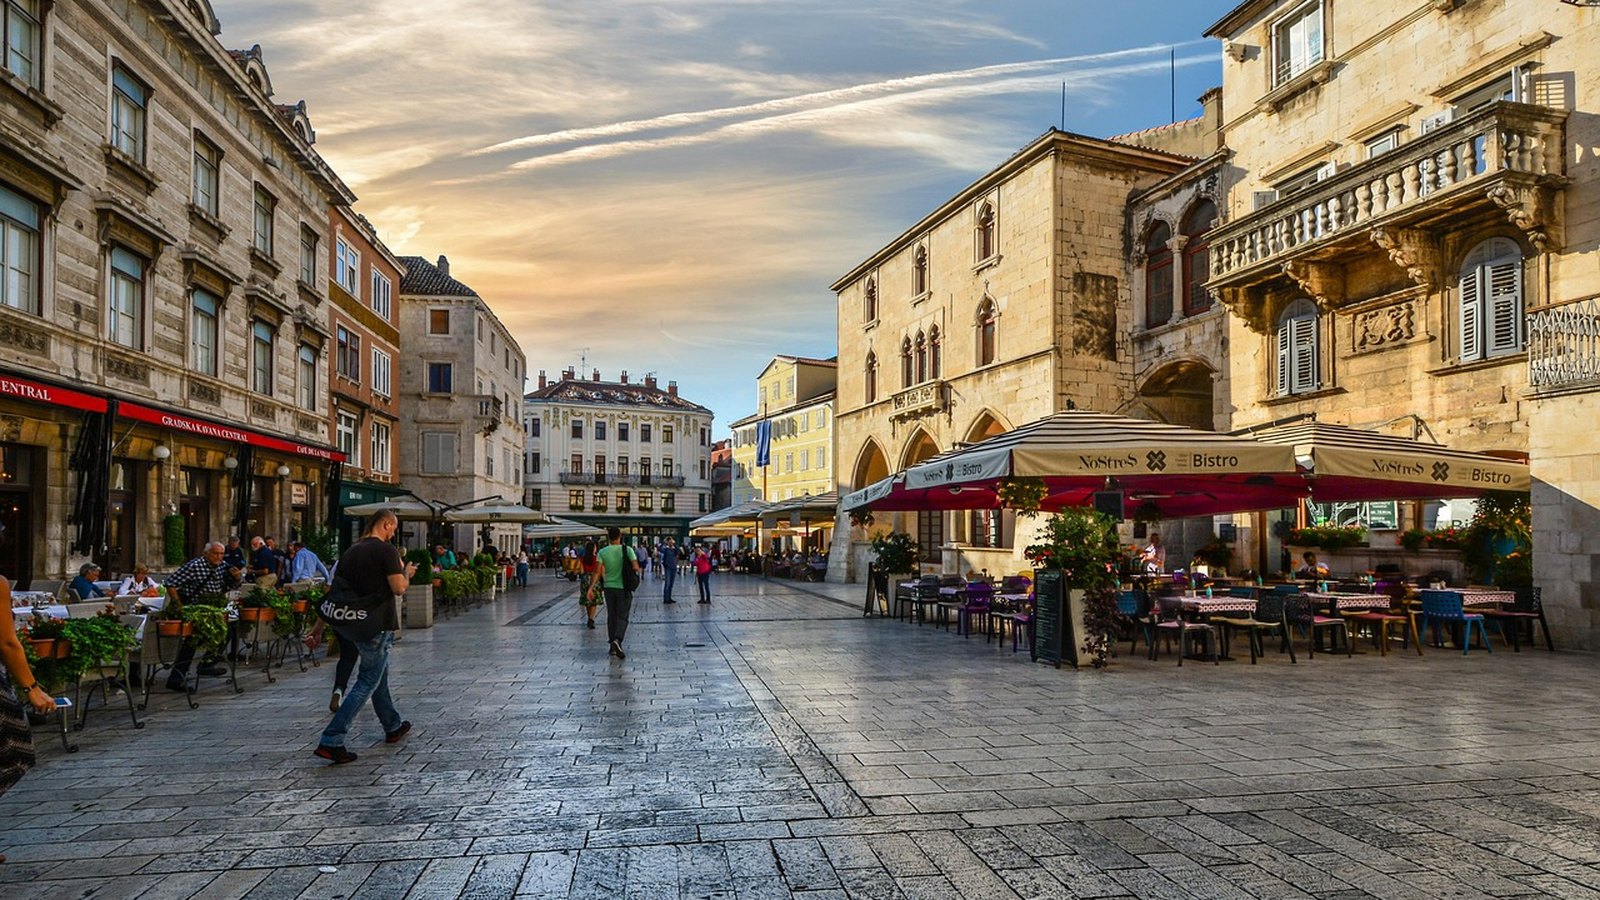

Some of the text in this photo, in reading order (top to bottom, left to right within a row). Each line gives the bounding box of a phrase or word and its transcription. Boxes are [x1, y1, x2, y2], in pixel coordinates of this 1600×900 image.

[0, 380, 52, 401] ENTRAL
[161, 415, 249, 442] GRADSKA KAVANA CENTRAL
[1193, 453, 1239, 468] Bistro
[962, 463, 983, 477] Bistro
[1471, 467, 1512, 485] Bistro
